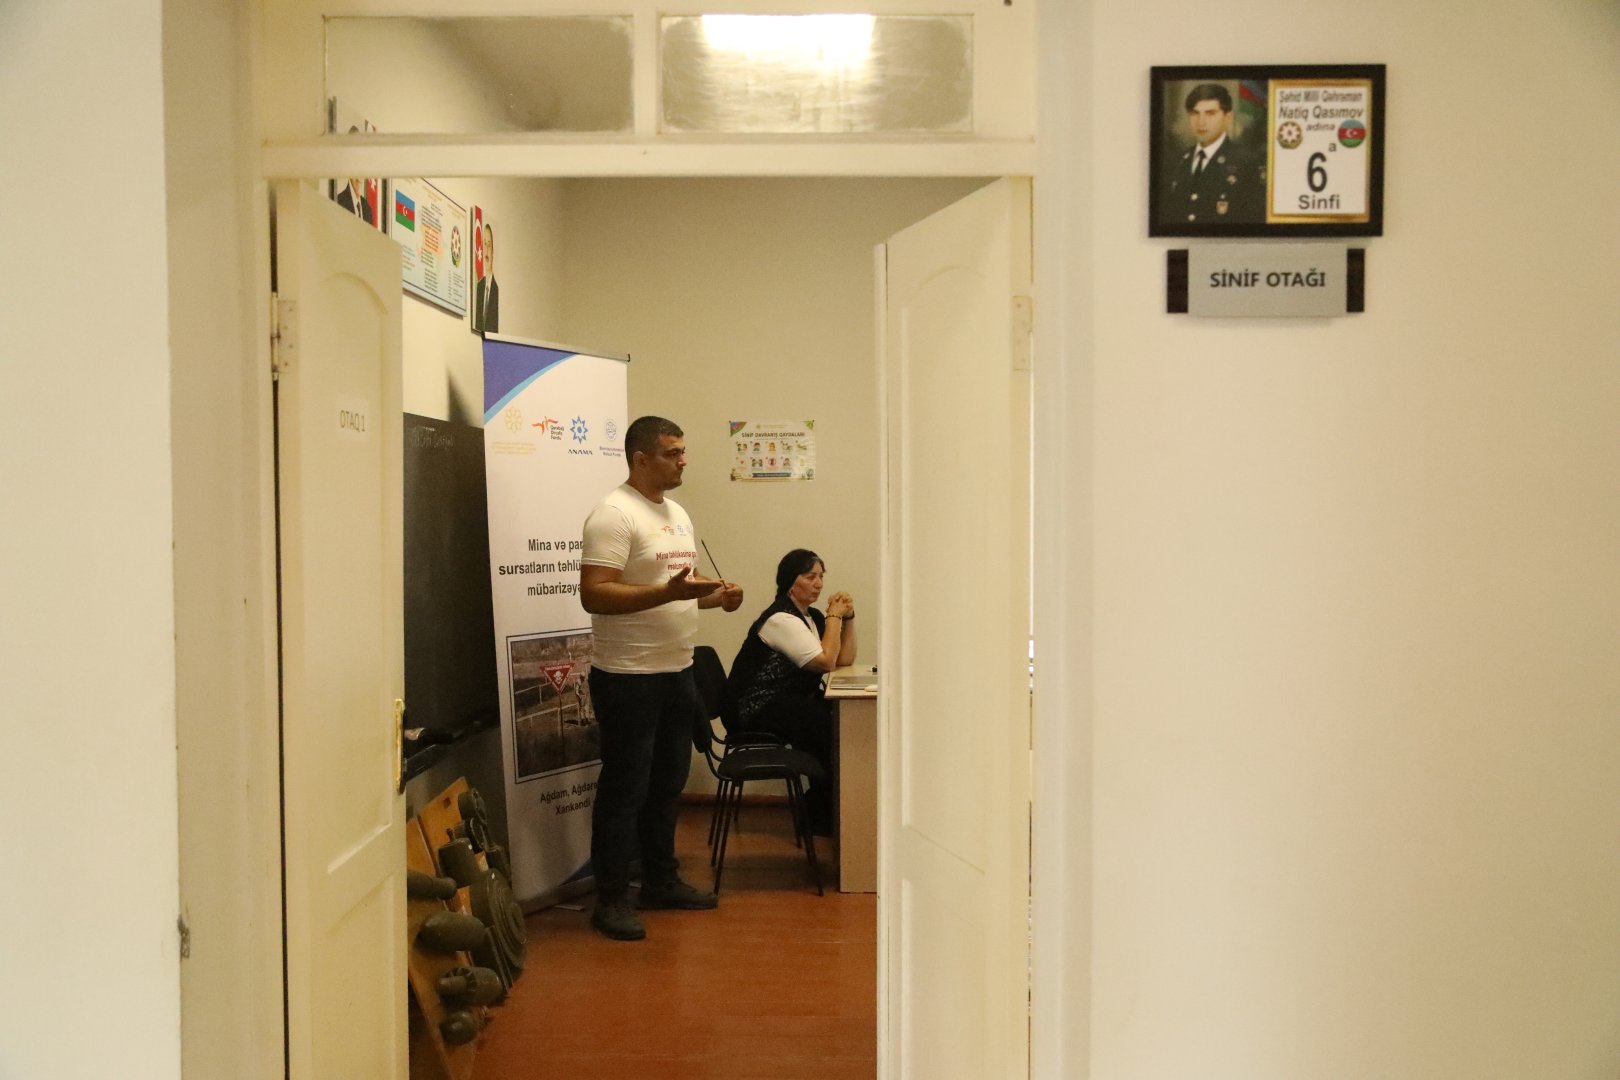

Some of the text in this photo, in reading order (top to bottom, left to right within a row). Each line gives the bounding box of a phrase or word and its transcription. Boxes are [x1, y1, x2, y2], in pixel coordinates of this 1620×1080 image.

[1279, 105, 1309, 121] Natiq
[1307, 152, 1328, 193] 6
[1298, 194, 1340, 210] Sinfi
[1210, 268, 1326, 287] SİNİF OTAĞI
[340, 410, 365, 432] OTAQ 1
[528, 538, 551, 551] Mina
[554, 541, 566, 550] və
[499, 561, 555, 576] sursatların
[540, 789, 569, 803] Ağdam,
